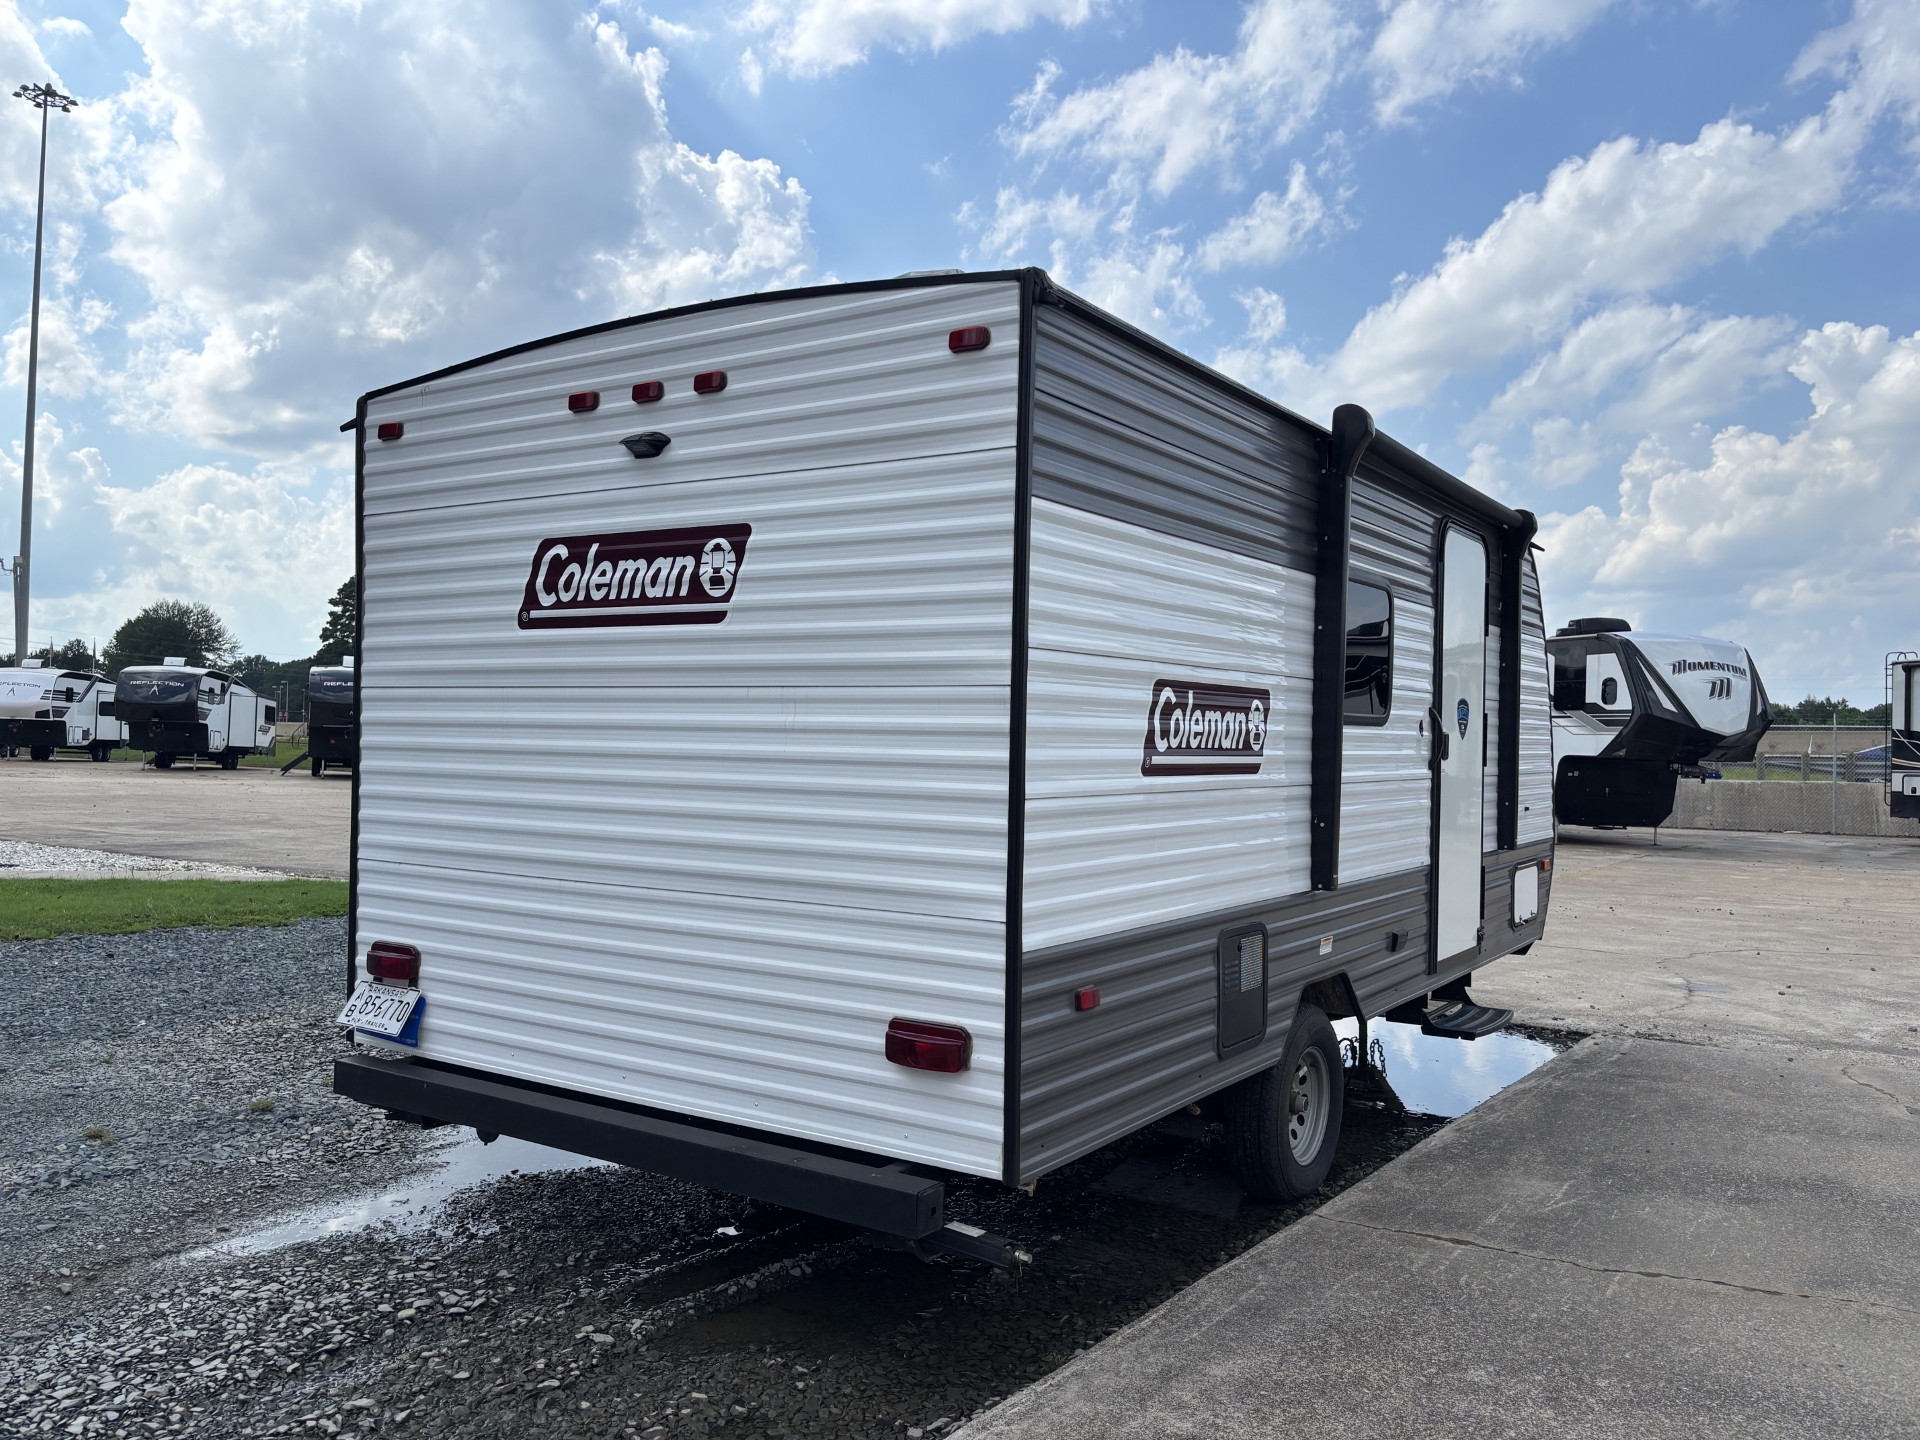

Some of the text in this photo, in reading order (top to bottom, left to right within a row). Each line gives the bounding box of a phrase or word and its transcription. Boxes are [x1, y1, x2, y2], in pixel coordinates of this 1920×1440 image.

[536, 543, 695, 607] Coleman
[1670, 659, 1747, 678] MOMENTUM
[1154, 687, 1246, 753] Coleman
[368, 985, 405, 998] ARKANSAS
[359, 994, 410, 1022] 856770
[365, 1019, 386, 1029] TRAILER
